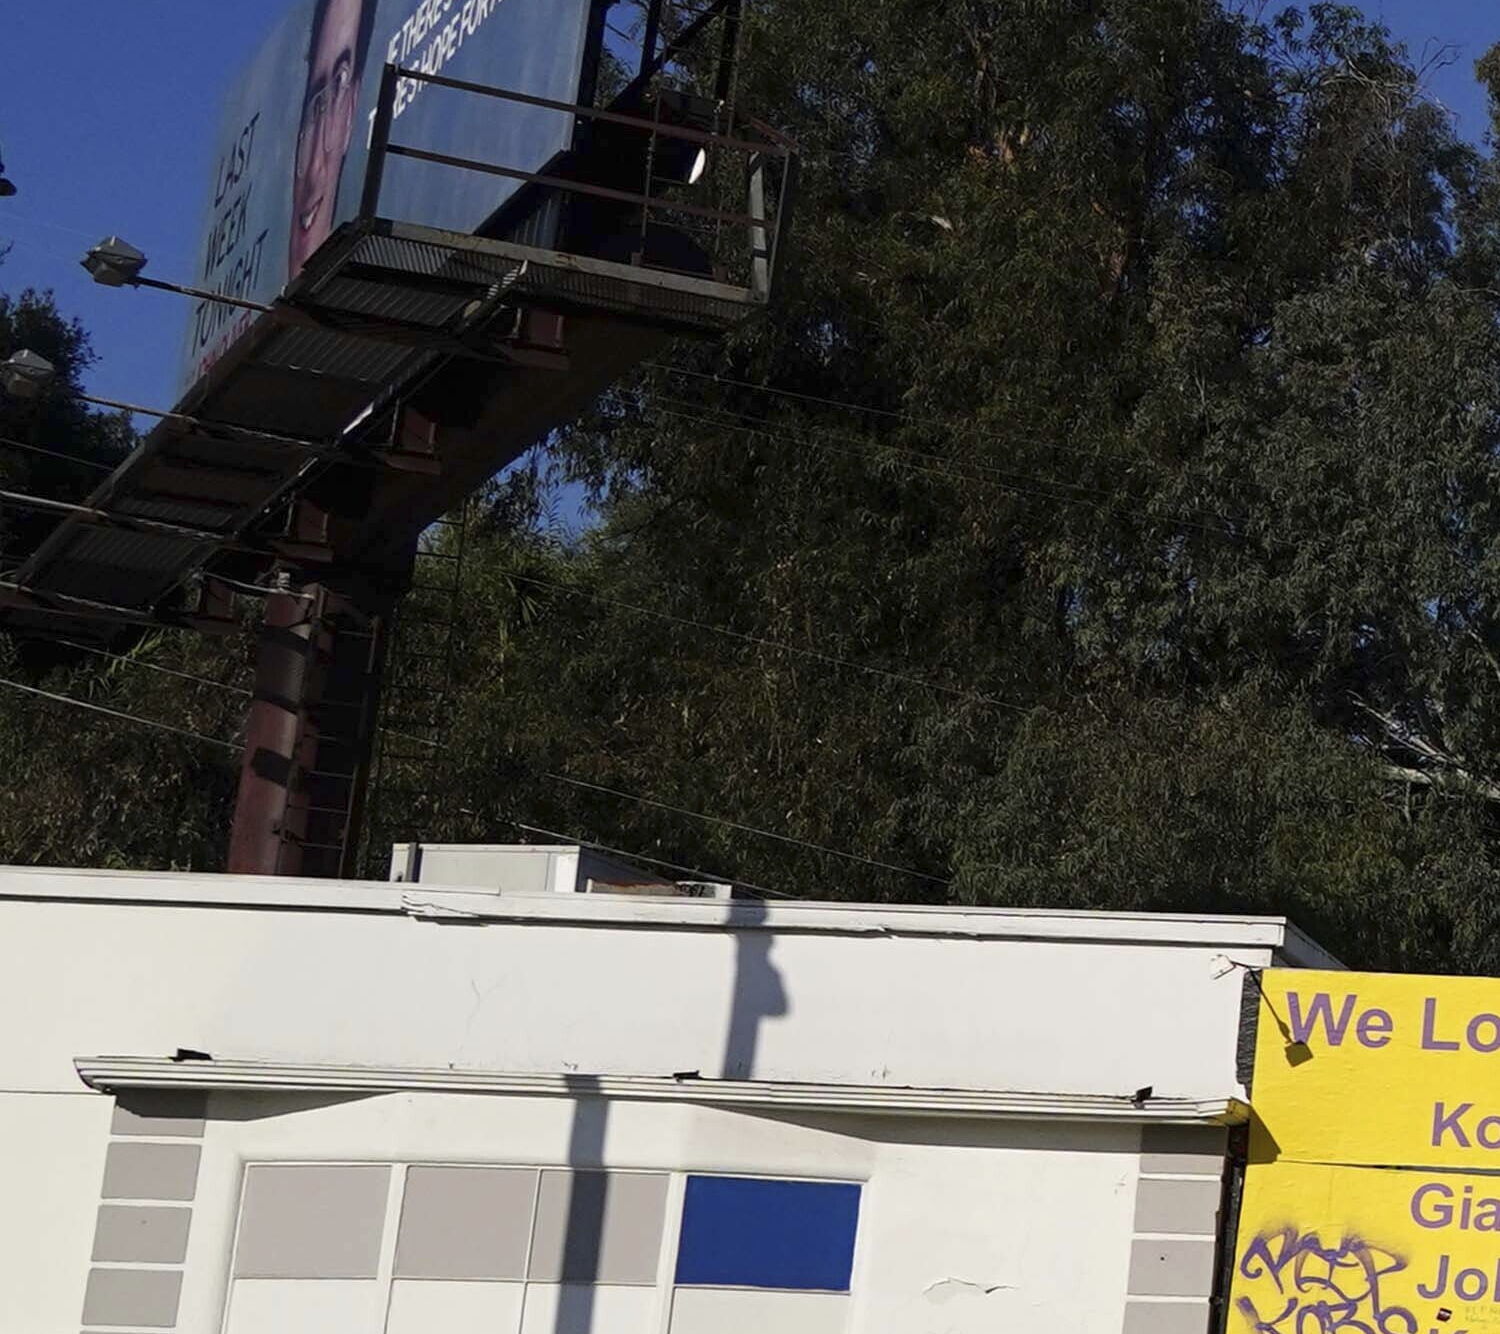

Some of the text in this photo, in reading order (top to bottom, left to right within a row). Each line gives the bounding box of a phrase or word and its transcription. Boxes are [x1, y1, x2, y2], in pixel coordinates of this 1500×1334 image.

[214, 112, 260, 209] LAST
[204, 181, 252, 281] WEEK
[1286, 991, 1395, 1049] We
